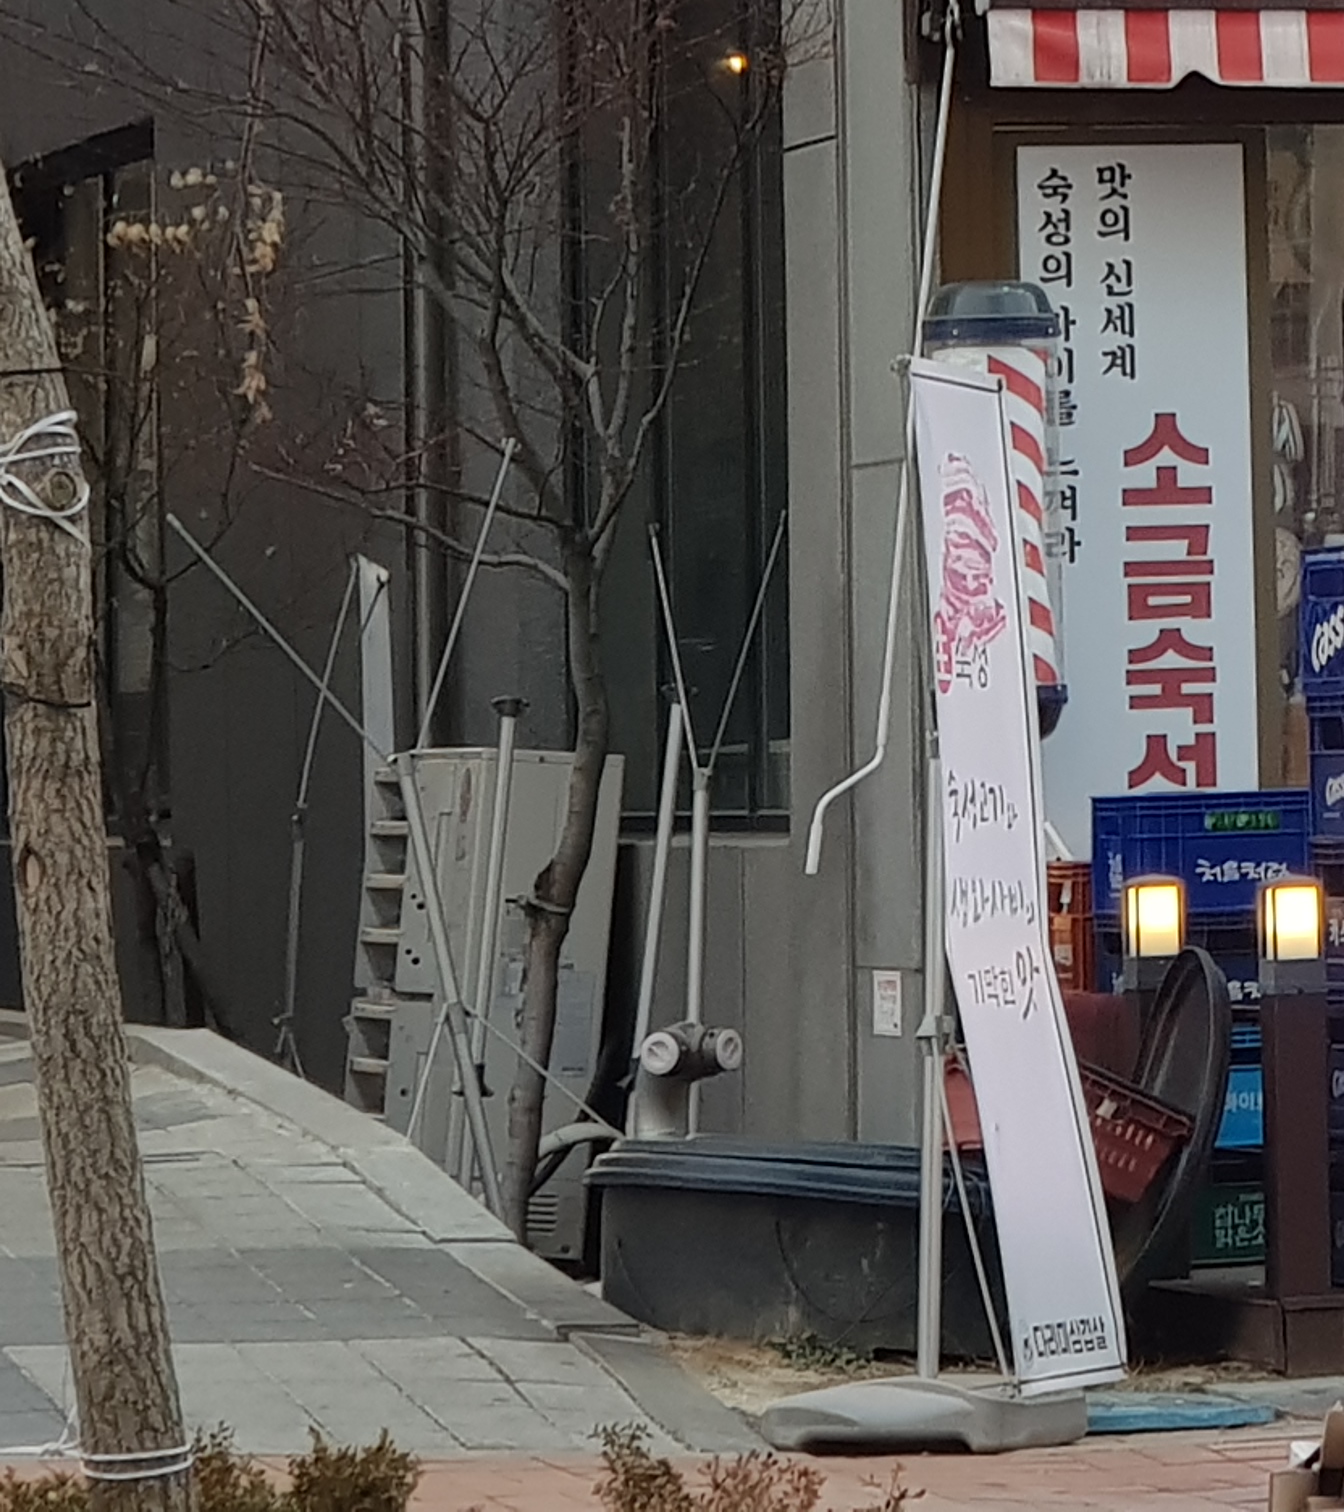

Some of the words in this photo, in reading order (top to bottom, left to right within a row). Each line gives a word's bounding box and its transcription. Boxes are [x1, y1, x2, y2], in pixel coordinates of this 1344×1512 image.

[1036, 166, 1074, 289] 숙성의
[1096, 161, 1133, 242] 맛의
[1100, 258, 1137, 381] 신세계
